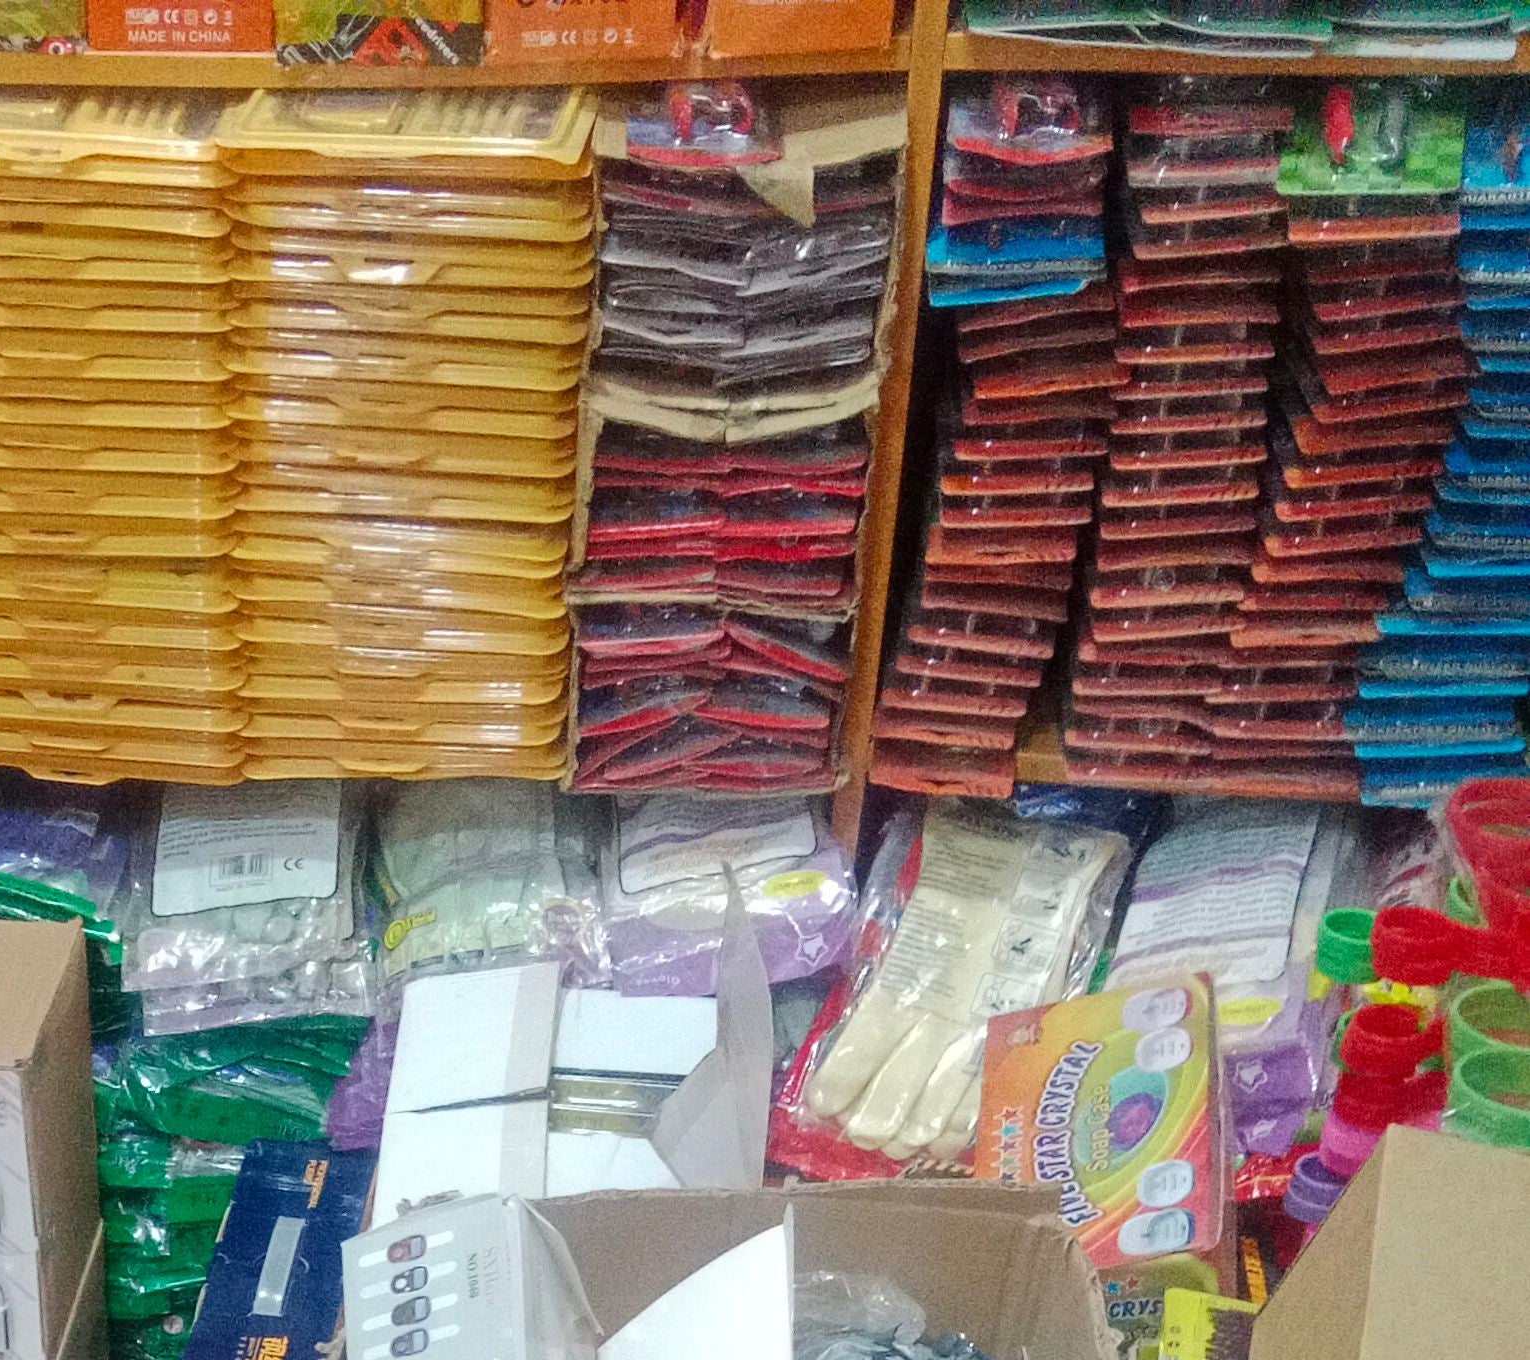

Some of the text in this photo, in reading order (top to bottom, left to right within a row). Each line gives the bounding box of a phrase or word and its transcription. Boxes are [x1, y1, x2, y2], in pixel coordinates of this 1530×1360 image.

[127, 30, 231, 43] MADE IN CHINA
[1035, 1040, 1105, 1129] CRYSTAL
[1084, 1083, 1113, 1174] Soap Case
[1033, 1129, 1074, 1183] STAR
[1107, 1299, 1164, 1320] CRYS
